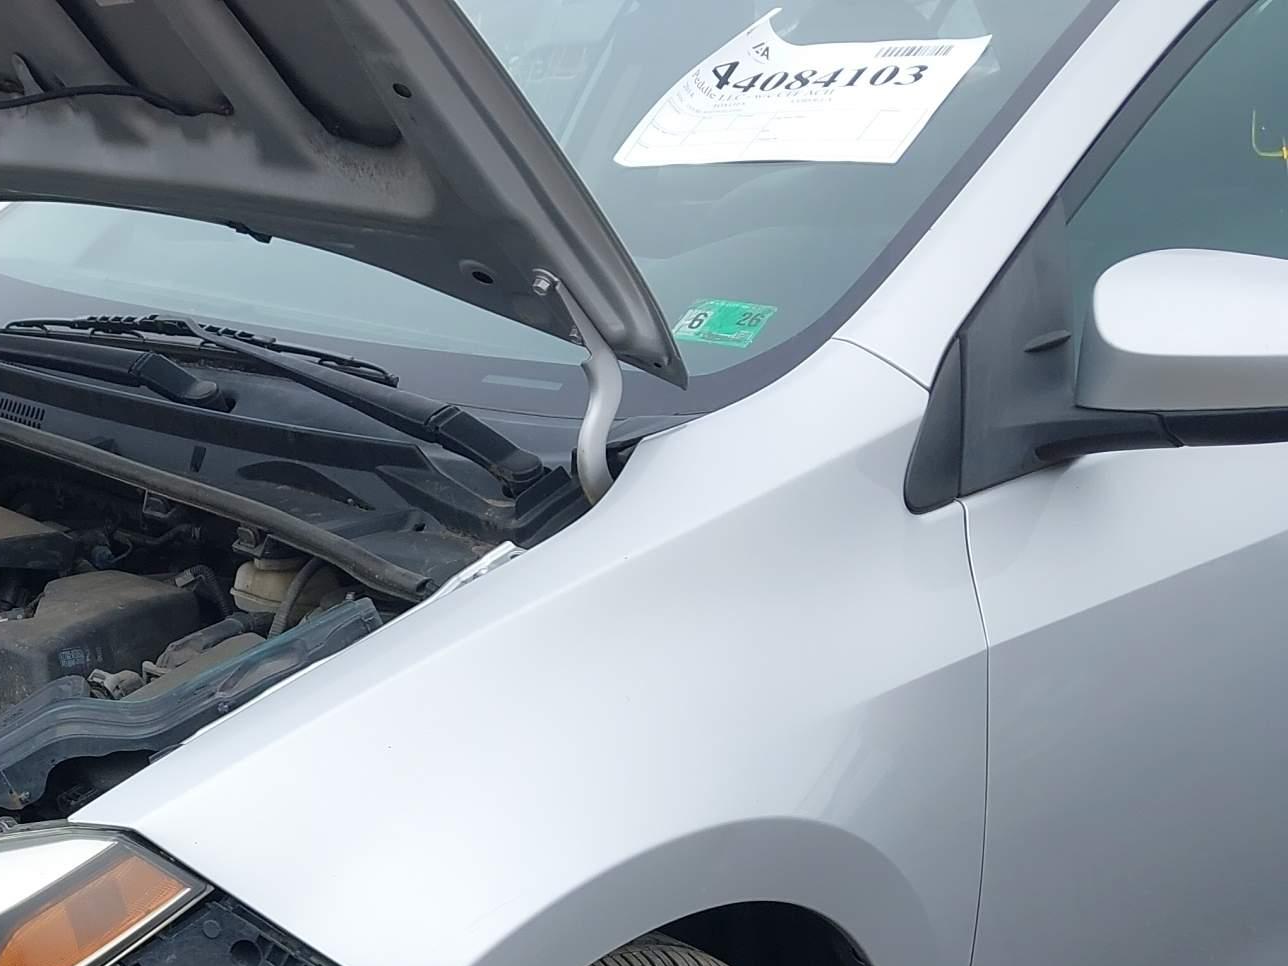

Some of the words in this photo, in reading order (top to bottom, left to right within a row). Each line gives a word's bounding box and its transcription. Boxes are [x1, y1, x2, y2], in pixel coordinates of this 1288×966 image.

[712, 61, 928, 92] 44084103
[688, 313, 708, 330] 6
[736, 312, 765, 327] 26
